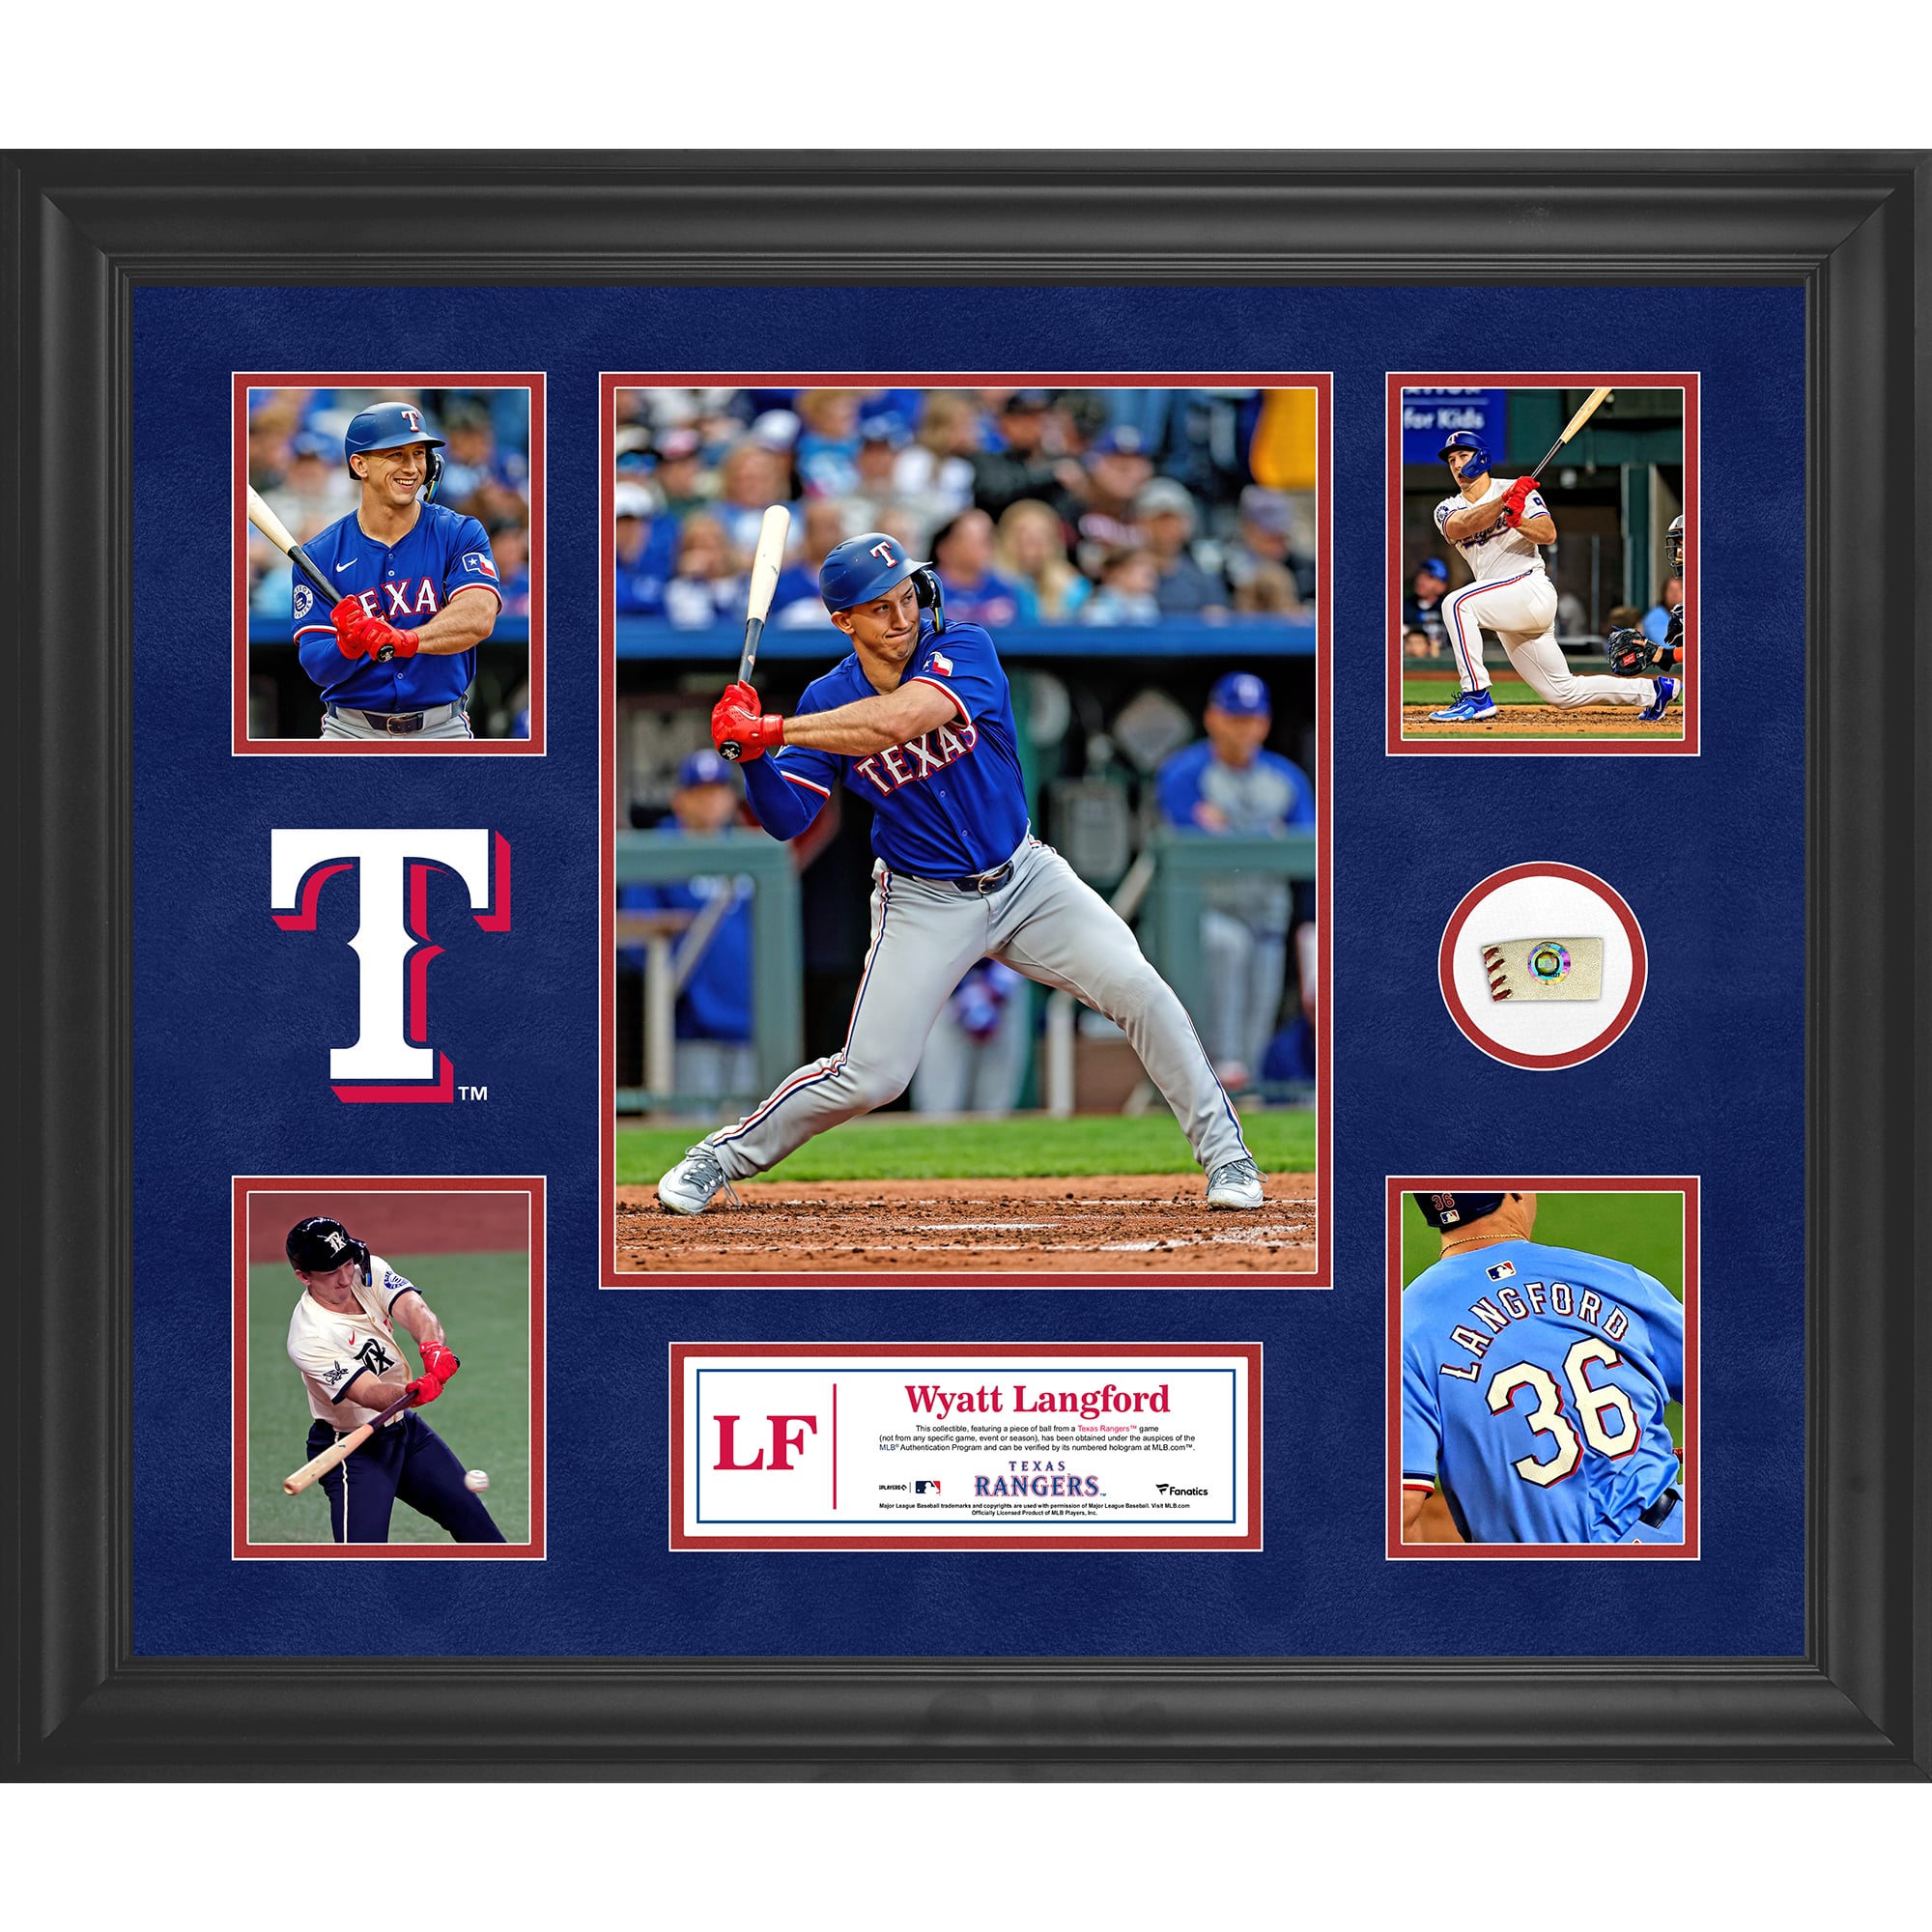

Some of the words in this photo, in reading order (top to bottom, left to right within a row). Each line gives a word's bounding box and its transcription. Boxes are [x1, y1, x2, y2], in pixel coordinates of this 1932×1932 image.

[1436, 407, 1485, 430] Kids
[869, 541, 898, 569] T
[355, 577, 445, 620] EXA
[1432, 1193, 1456, 1211] 36
[1439, 1281, 1630, 1383] LANGFORD
[904, 1384, 1003, 1420] Wyatt
[1013, 1383, 1171, 1420] Langford
[1485, 1337, 1642, 1489] 36
[932, 1425, 970, 1435] collectible,
[971, 1425, 1002, 1435] featuring
[1010, 1425, 1029, 1435] piece
[1139, 1426, 1159, 1435] game
[713, 1415, 818, 1471] LF
[1009, 1461, 1065, 1472] TEXAS
[975, 1475, 1099, 1497] RANGERS
[1170, 1487, 1208, 1495] Fanatics
